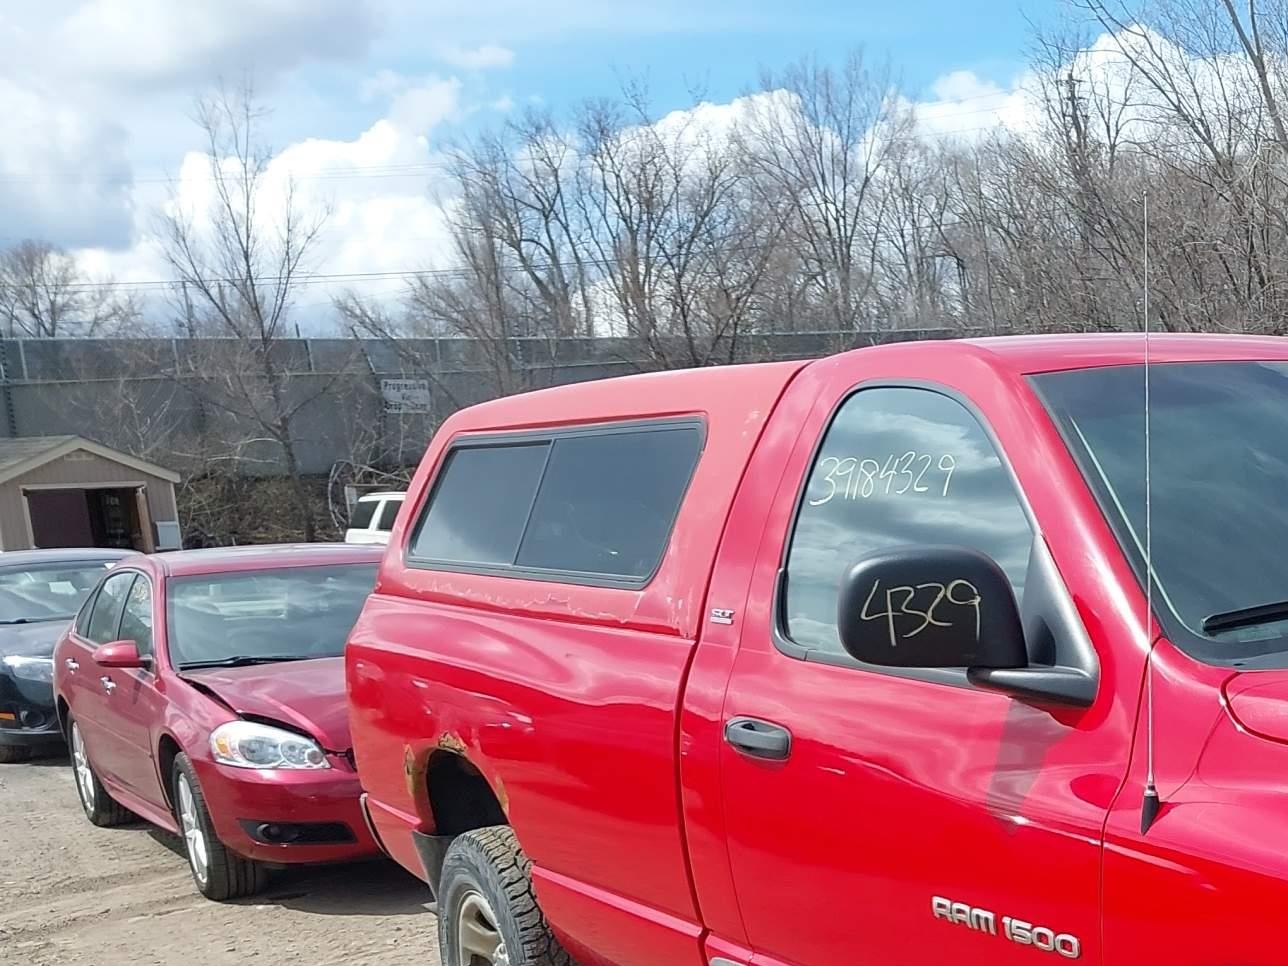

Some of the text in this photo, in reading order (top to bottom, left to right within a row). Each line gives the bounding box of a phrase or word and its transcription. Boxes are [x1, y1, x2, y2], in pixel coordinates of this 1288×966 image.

[808, 450, 957, 507] 39184329
[860, 578, 982, 648] 4329
[930, 895, 1082, 960] RAM 1500
